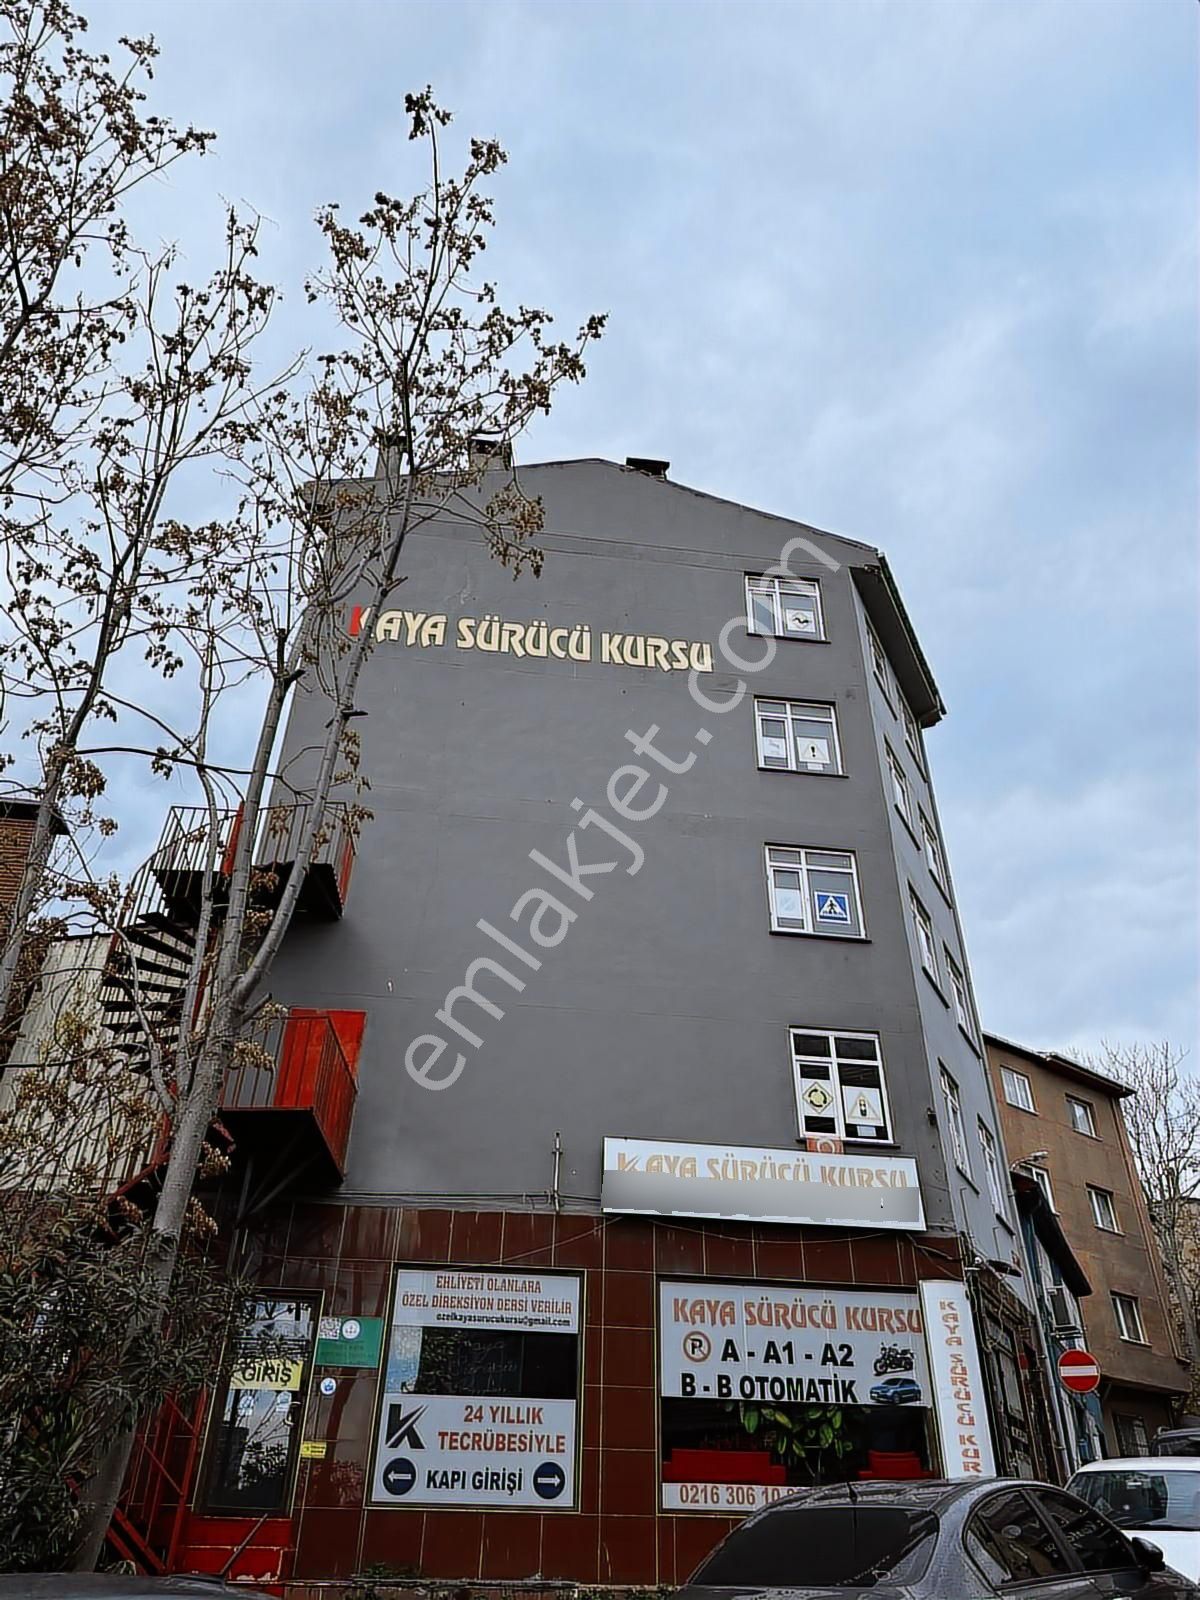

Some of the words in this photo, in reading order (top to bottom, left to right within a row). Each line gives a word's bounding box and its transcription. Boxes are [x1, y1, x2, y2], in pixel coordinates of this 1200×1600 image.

[348, 606, 448, 648] KAYA
[456, 614, 591, 662] SÜRÜCÜ
[600, 631, 714, 673] KURSU
[436, 1273, 485, 1290] EHLİYETİ
[487, 1277, 542, 1294] OLANLARA
[402, 1290, 429, 1308] ÖZEL
[431, 1291, 494, 1311] DİREKSİYON
[497, 1297, 528, 1313] DERSİ
[531, 1299, 572, 1315] VERİLİR
[673, 1297, 736, 1327] KAYA
[744, 1296, 838, 1331] SÜRÜCÜ
[845, 1306, 922, 1335] KURSU
[721, 1338, 740, 1362] A
[763, 1340, 795, 1365] A1
[820, 1343, 855, 1367] A2
[681, 1373, 696, 1397] B
[717, 1373, 732, 1398] B
[739, 1373, 858, 1403] OTOMATİK
[464, 1405, 484, 1423] 24
[489, 1406, 544, 1424] YILLIK
[438, 1428, 566, 1453] TECRÜBESİYLE
[426, 1470, 466, 1490] KAPI
[472, 1467, 523, 1496] GİRİŞİ
[679, 1484, 720, 1504] 0216
[726, 1486, 756, 1505] 306
